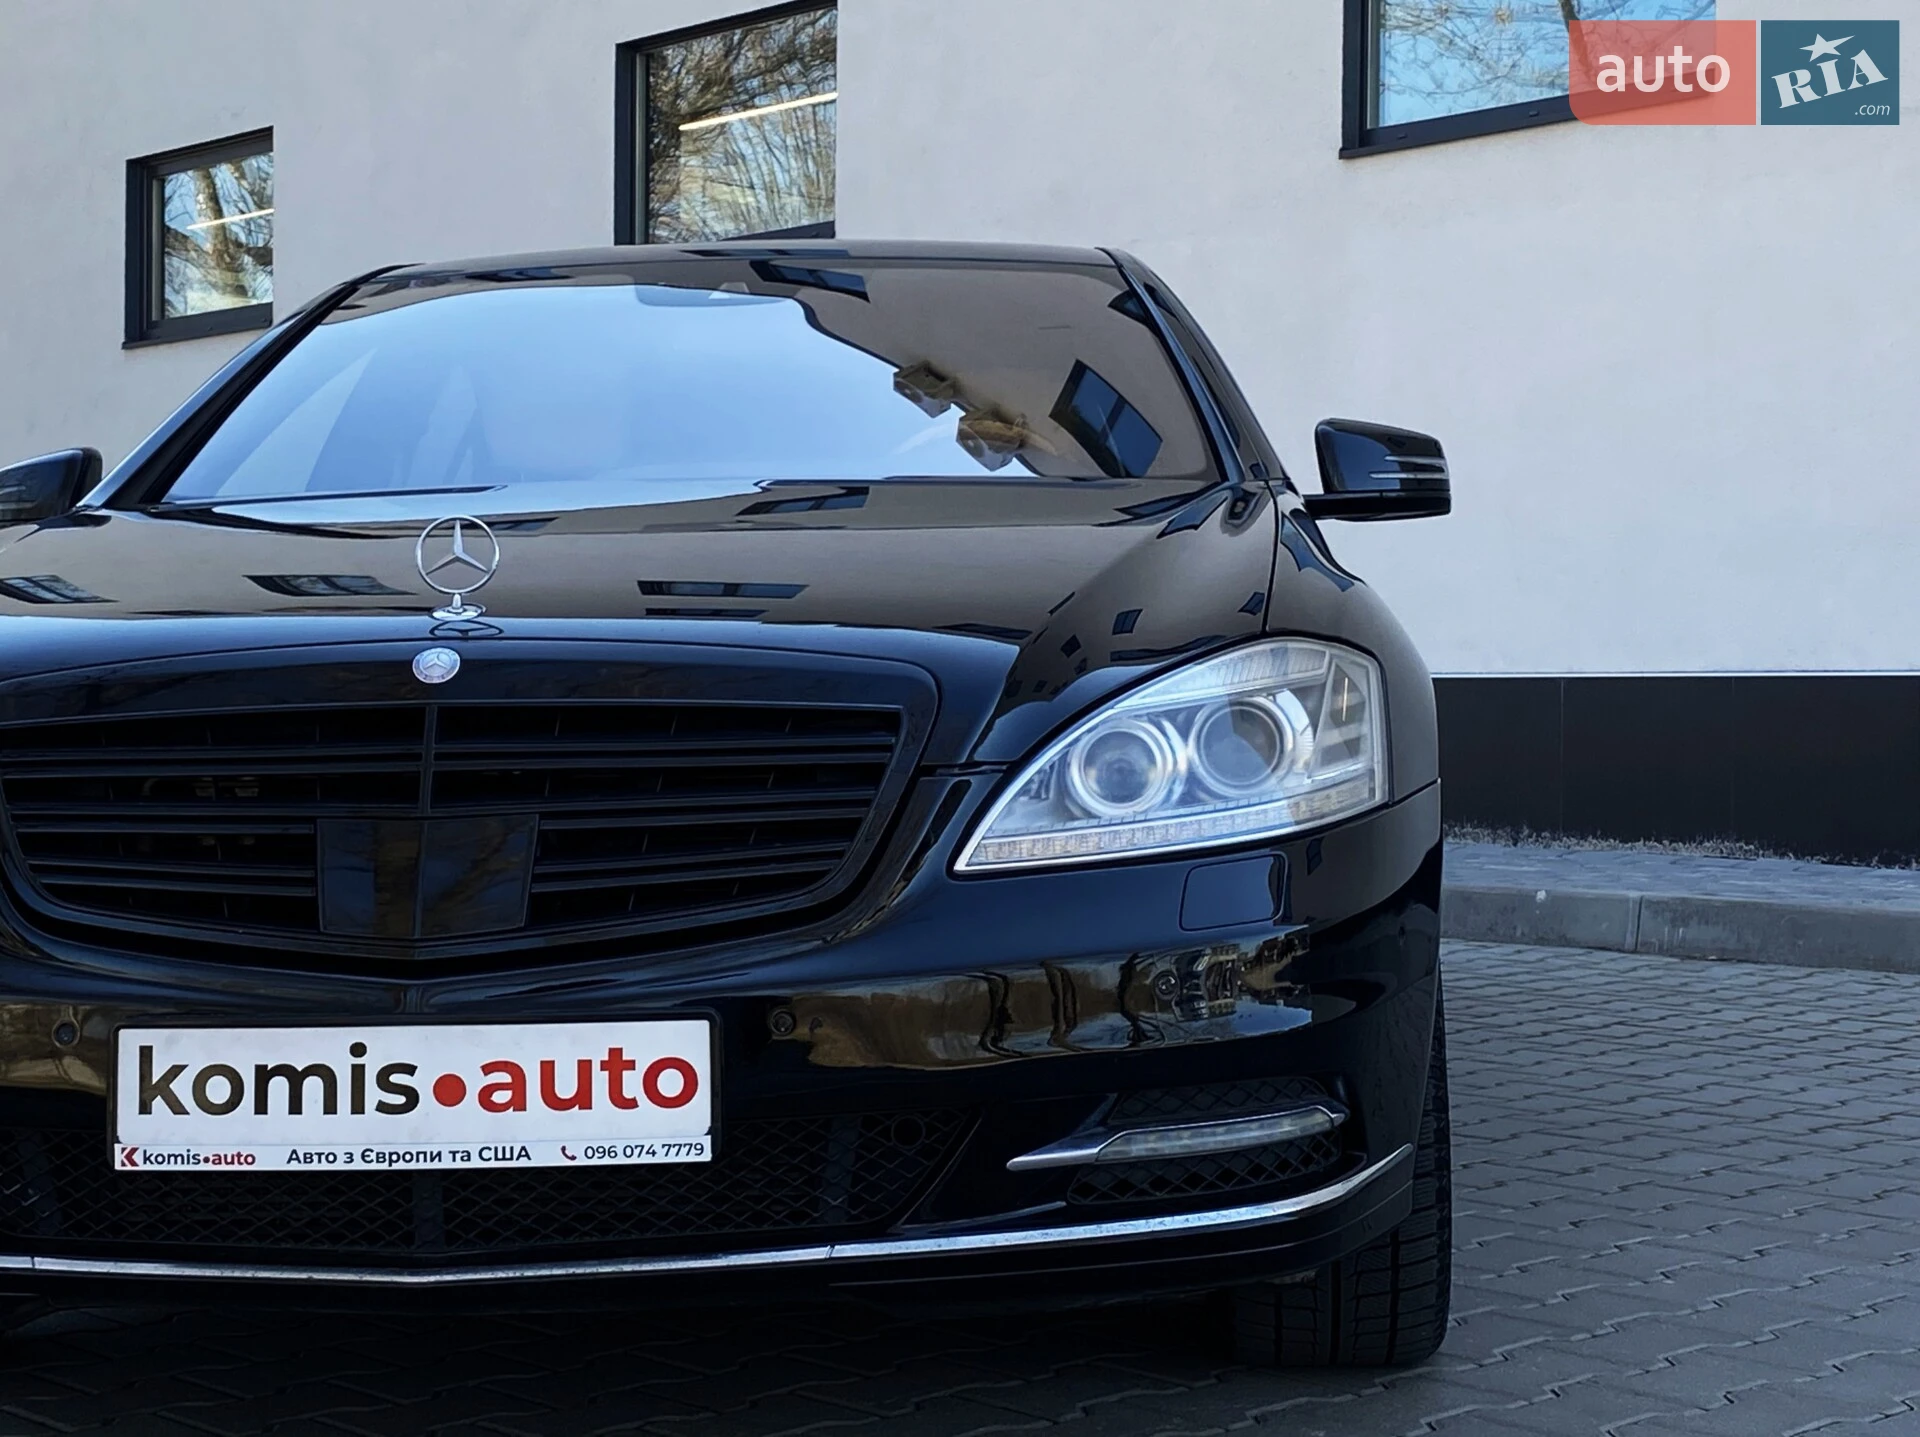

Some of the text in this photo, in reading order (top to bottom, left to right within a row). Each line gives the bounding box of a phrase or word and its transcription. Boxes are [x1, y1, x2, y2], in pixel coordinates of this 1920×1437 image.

[286, 1146, 532, 1168] Авто з Європи та США
[583, 1143, 705, 1160] 096 074 7779
